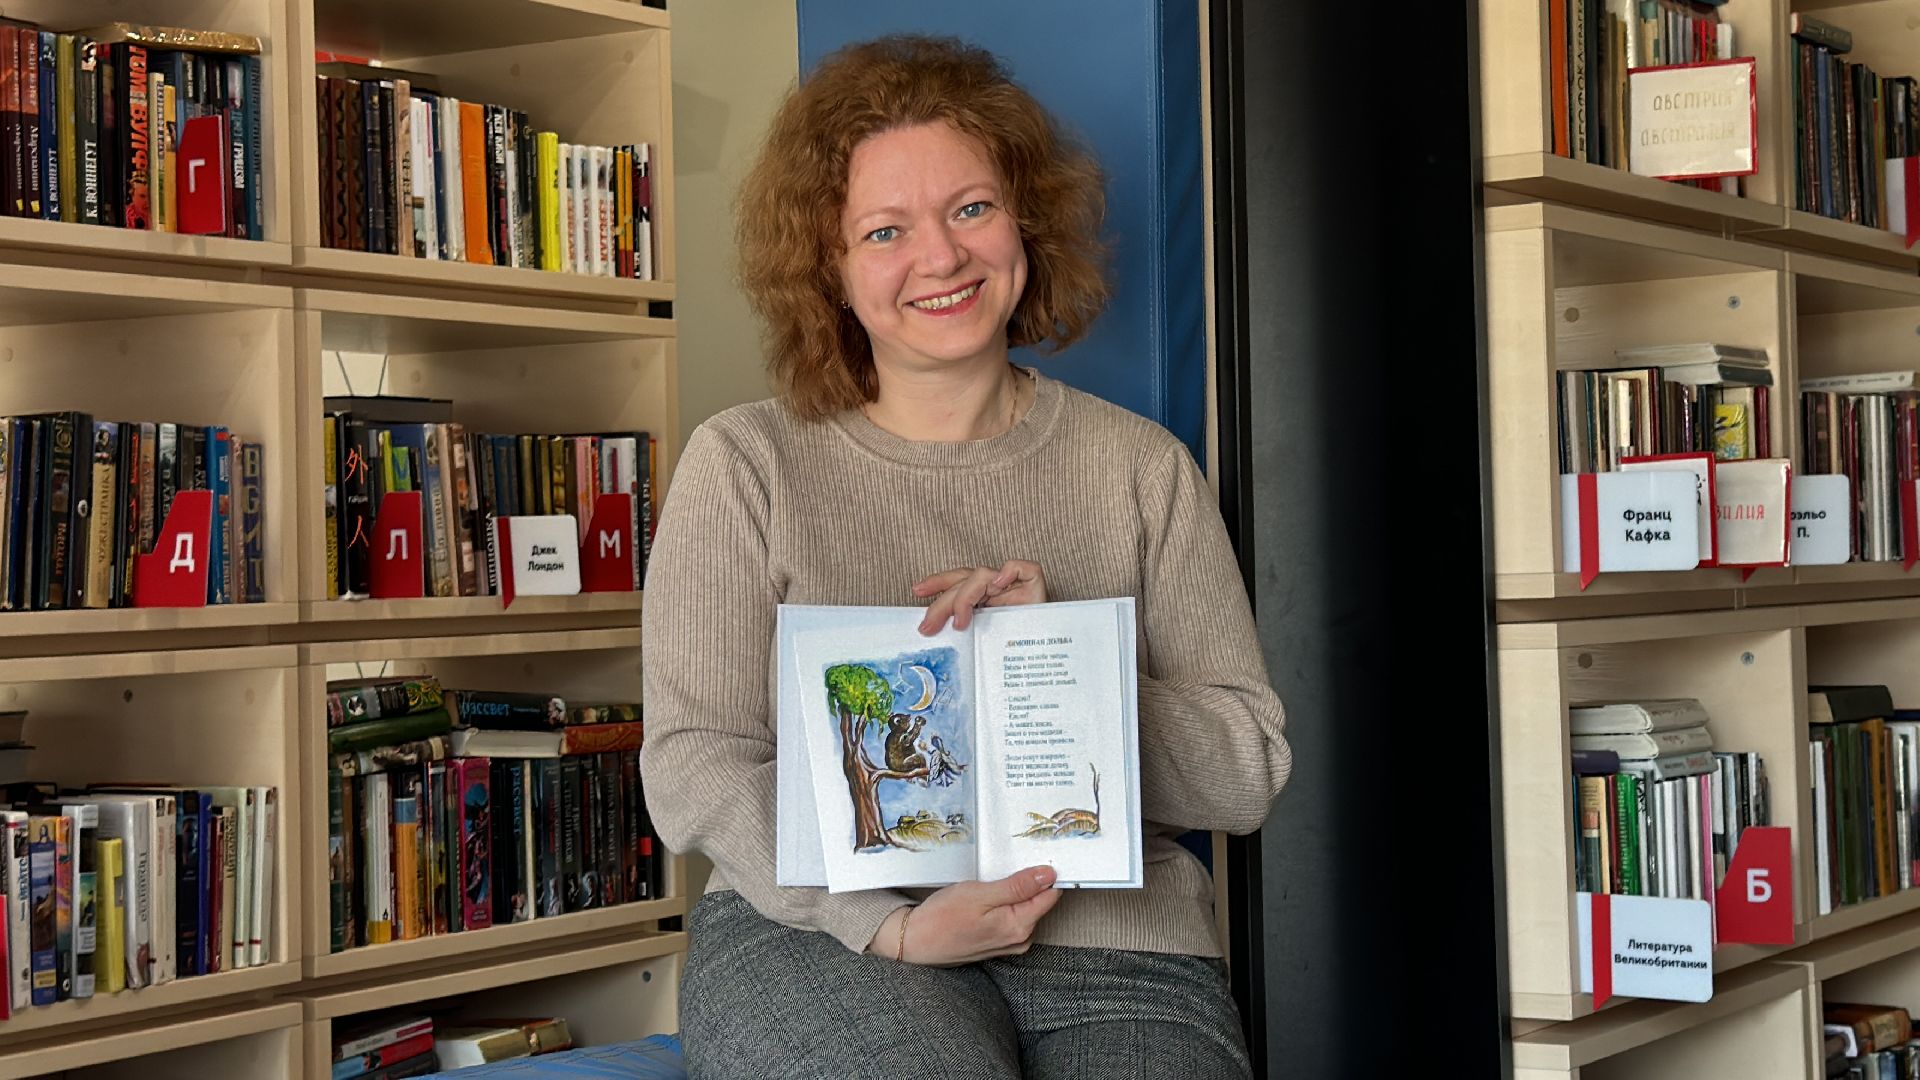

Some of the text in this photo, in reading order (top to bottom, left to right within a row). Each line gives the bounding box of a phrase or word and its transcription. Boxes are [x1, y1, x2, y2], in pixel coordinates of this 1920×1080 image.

[84, 139, 97, 203] ВОННЕГУТ
[188, 159, 206, 193] Г
[1622, 509, 1672, 523] Франц
[1790, 510, 1827, 521] оэльо
[1625, 528, 1671, 543] Кафка
[1796, 528, 1810, 538] П.
[386, 529, 408, 560] Л
[531, 545, 558, 558] Джек
[599, 530, 621, 559] М
[170, 532, 195, 574] Д
[528, 561, 564, 573] Лондон
[1746, 868, 1773, 903] Б
[1627, 939, 1693, 954] Литература
[1614, 954, 1708, 970] Великобритании
